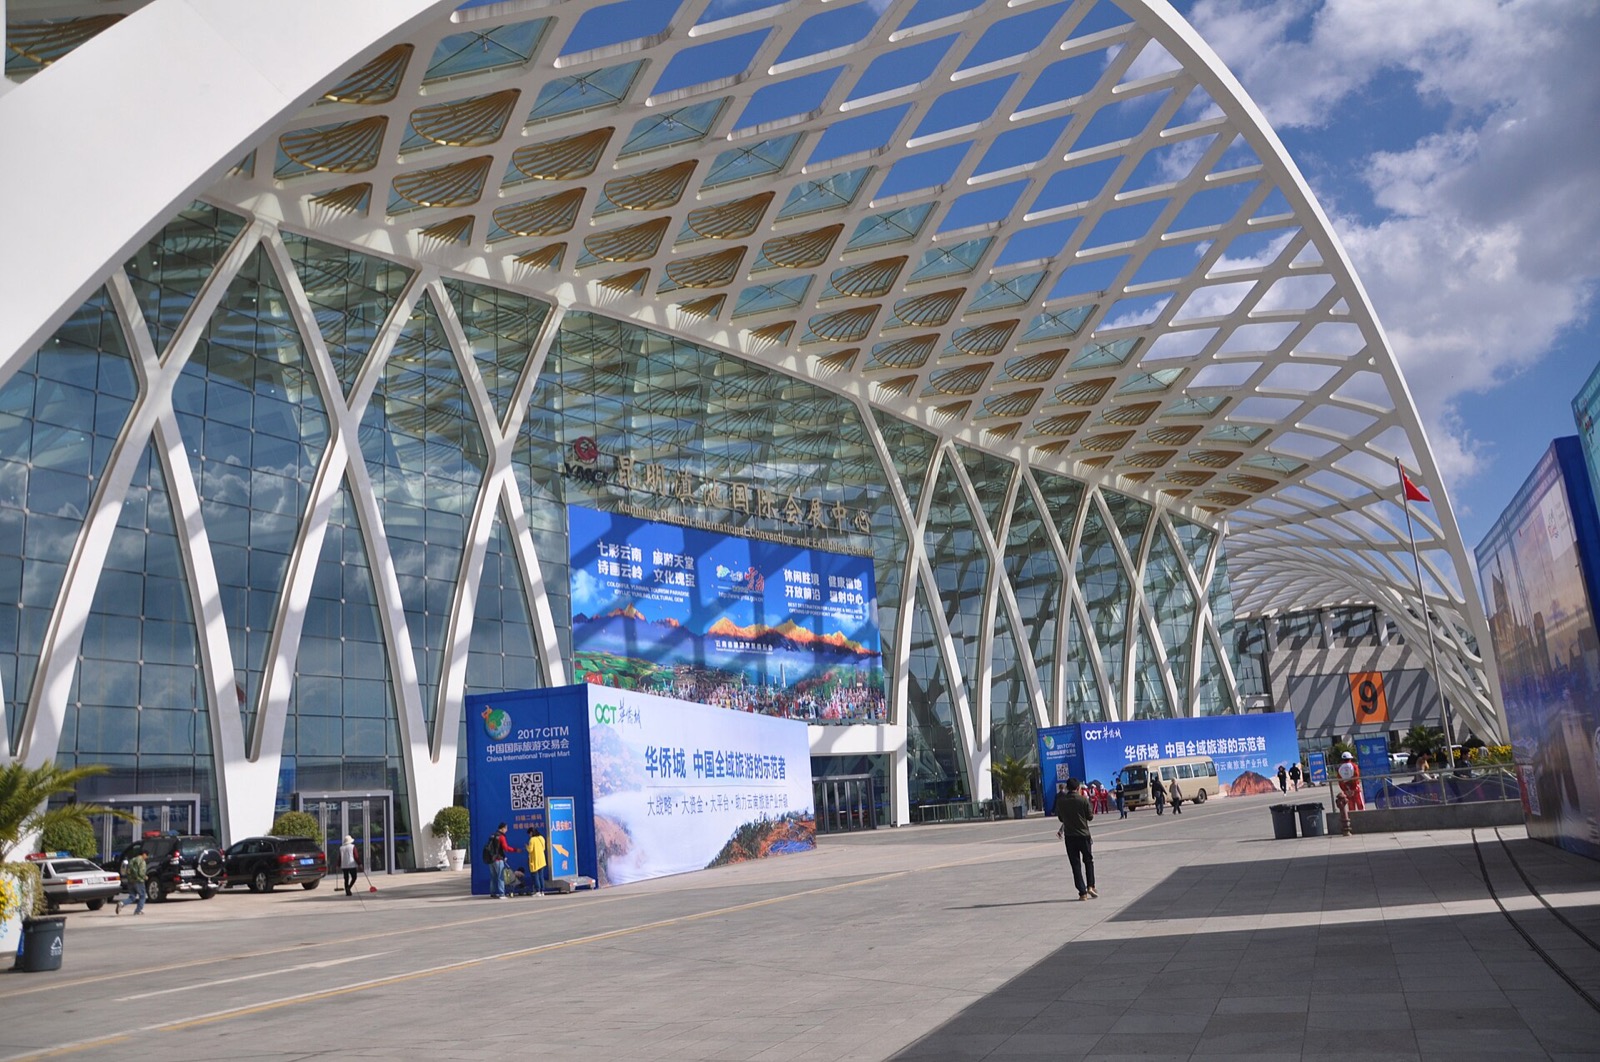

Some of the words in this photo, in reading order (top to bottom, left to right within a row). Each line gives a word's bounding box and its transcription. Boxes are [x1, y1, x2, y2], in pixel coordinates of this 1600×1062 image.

[618, 455, 872, 534] 昆明滇池国际会展中心
[618, 500, 657, 521] Kunming
[695, 518, 748, 537] International
[750, 527, 793, 545] Convention
[796, 537, 809, 548] and
[597, 541, 642, 562] 七彩云南
[653, 550, 694, 570] 旅游天堂
[598, 559, 643, 580] 诗画云岭
[653, 568, 696, 588] 文化瑰宝
[785, 585, 821, 601] 开放前沿
[1359, 680, 1378, 715] 9
[595, 703, 617, 725] OCT
[518, 728, 541, 739] 2017
[543, 726, 569, 738] CITM
[1085, 730, 1102, 740] OCT
[486, 755, 503, 763] China
[503, 753, 538, 761] International
[487, 738, 569, 755] 中国国际旅游交易会
[1124, 743, 1160, 762] 华侨城
[1165, 736, 1266, 758] 中国全域旅游的示范者
[645, 745, 687, 779] 华侨城
[693, 749, 786, 780] 中国全域旅游的示范者
